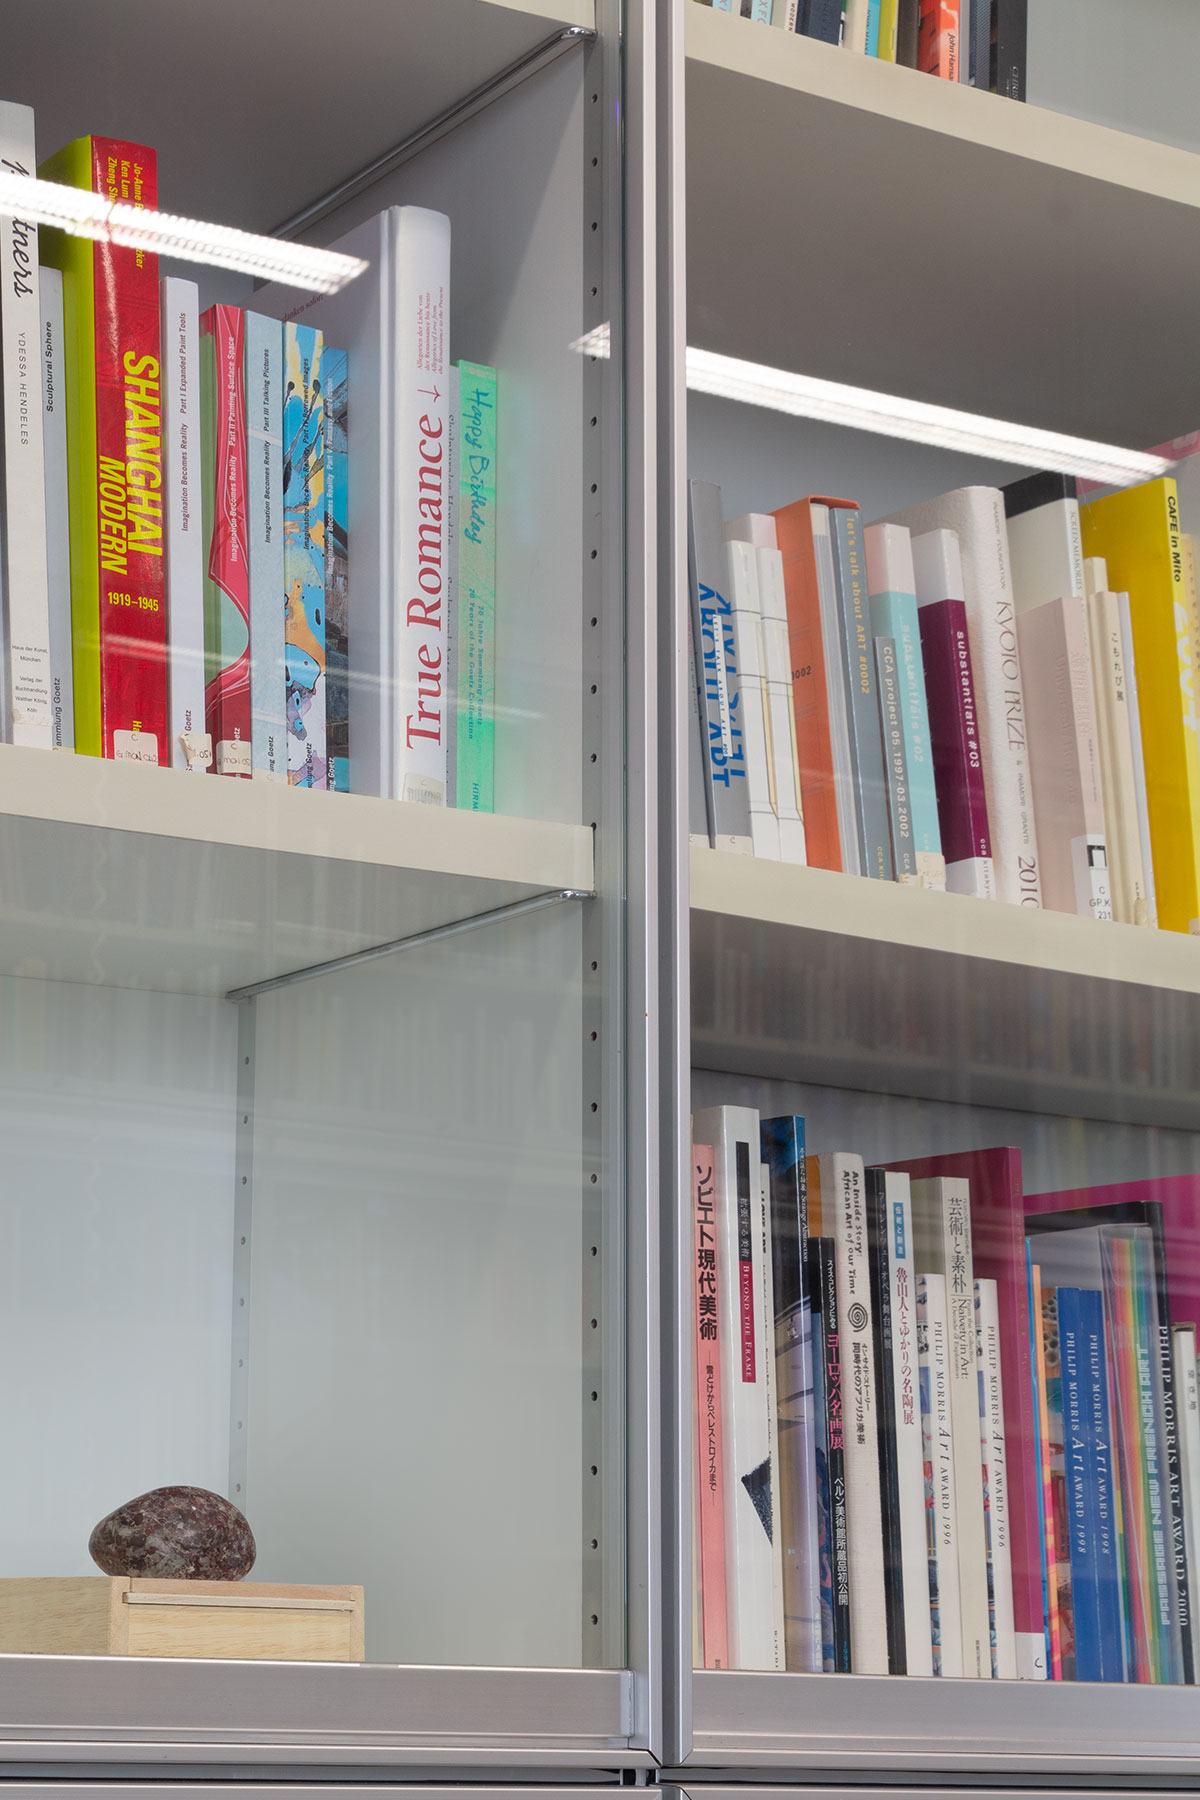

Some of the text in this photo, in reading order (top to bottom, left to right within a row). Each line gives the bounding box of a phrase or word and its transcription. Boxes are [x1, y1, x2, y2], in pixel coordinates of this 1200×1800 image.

[97, 455, 127, 574] MODERN
[121, 351, 164, 556] SHANGHAI
[464, 388, 490, 544] Happy Birthday
[406, 414, 442, 749] True Romance
[1166, 496, 1181, 582] CAFE in Mito
[956, 630, 980, 767] substantials #03
[696, 1165, 717, 1341] ソビエト現代美術
[1158, 1325, 1187, 1625] PHILIP MORRIS ART AWARD 2000
